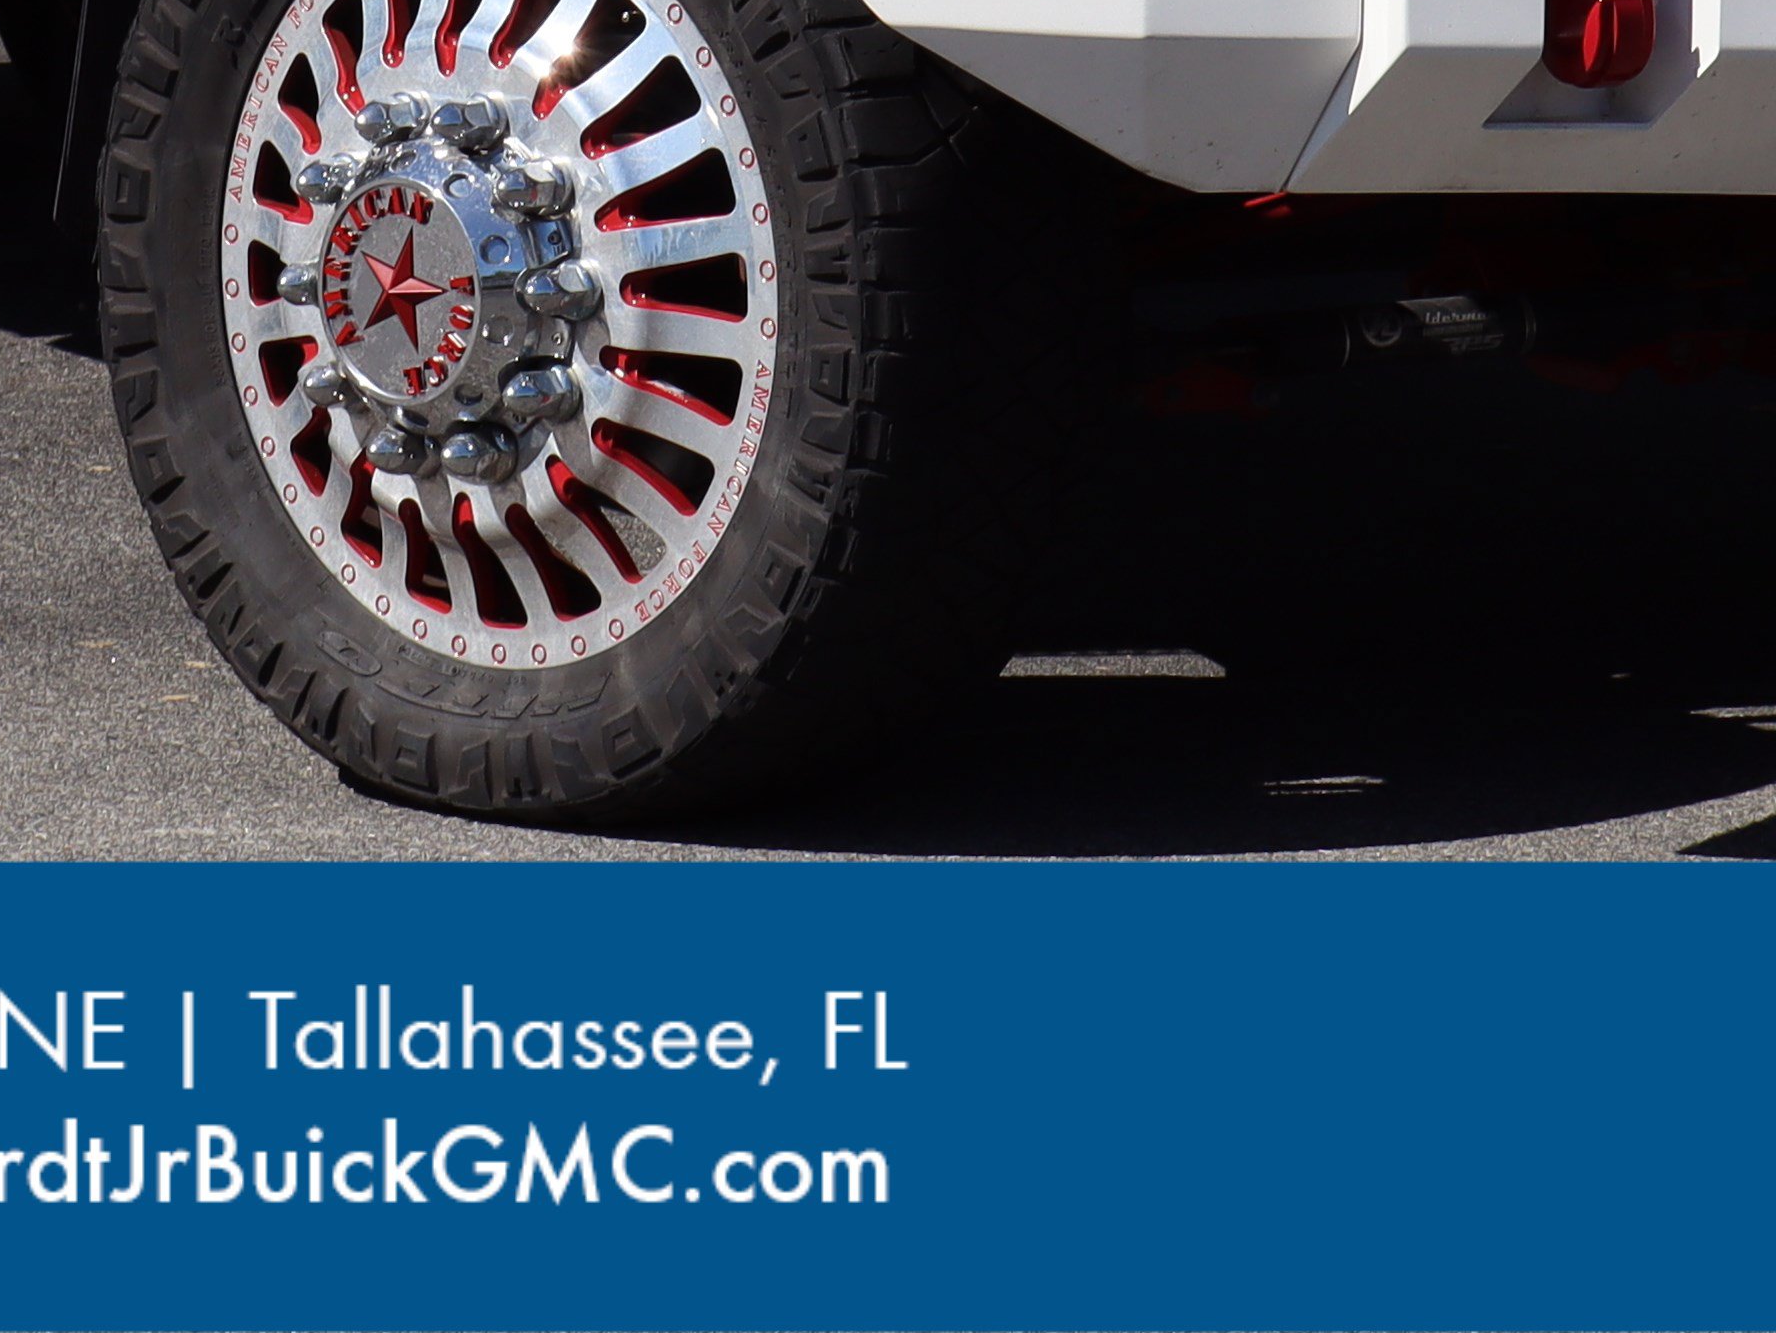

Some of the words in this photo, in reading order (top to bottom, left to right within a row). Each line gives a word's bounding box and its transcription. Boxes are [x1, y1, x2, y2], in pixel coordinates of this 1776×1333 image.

[229, 33, 289, 203] AMERICAN
[706, 359, 771, 537] AMERICAN
[634, 540, 708, 623] FORCE
